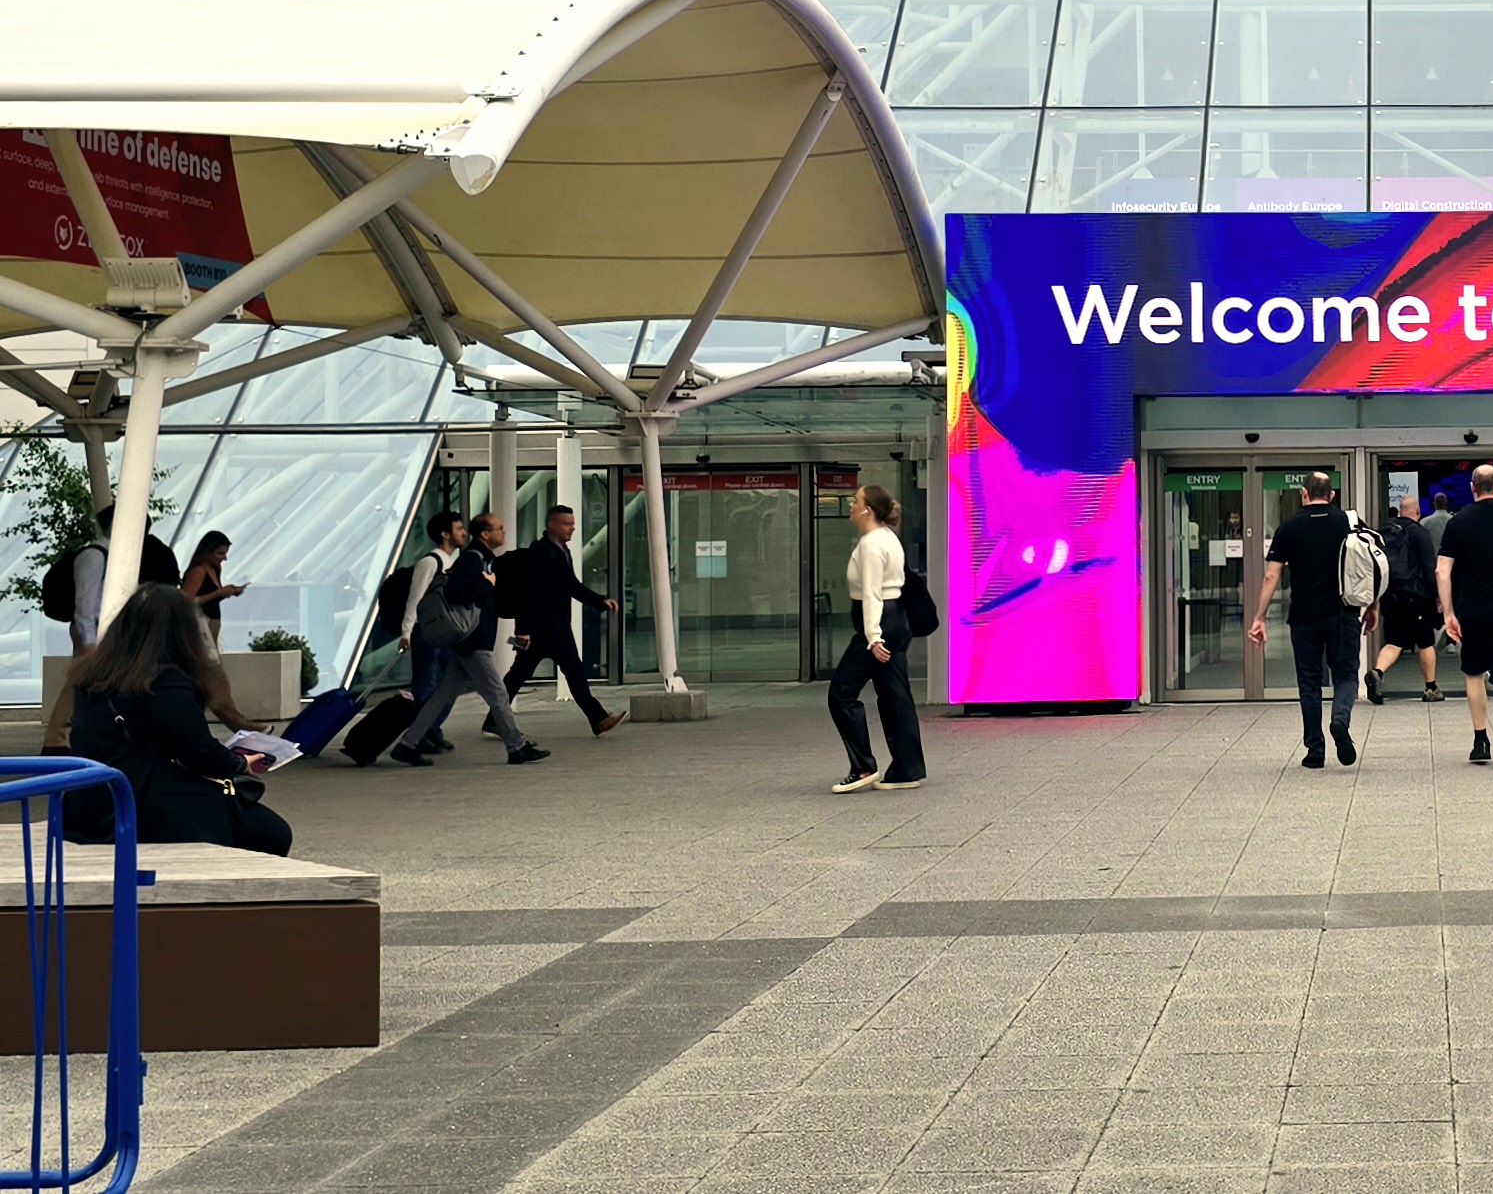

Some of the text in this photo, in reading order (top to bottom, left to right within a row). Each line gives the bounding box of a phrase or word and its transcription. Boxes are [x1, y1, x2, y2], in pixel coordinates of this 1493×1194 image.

[123, 131, 143, 163] of
[146, 137, 221, 183] defense
[1111, 201, 1177, 213] Infosecurity
[1248, 201, 1343, 212] Antibody Europe
[1382, 200, 1492, 212] Digital Construction
[1051, 281, 1430, 345] Welcome
[663, 477, 677, 485] XIT
[745, 475, 764, 484] EXIT
[1187, 475, 1221, 484] ENTRY
